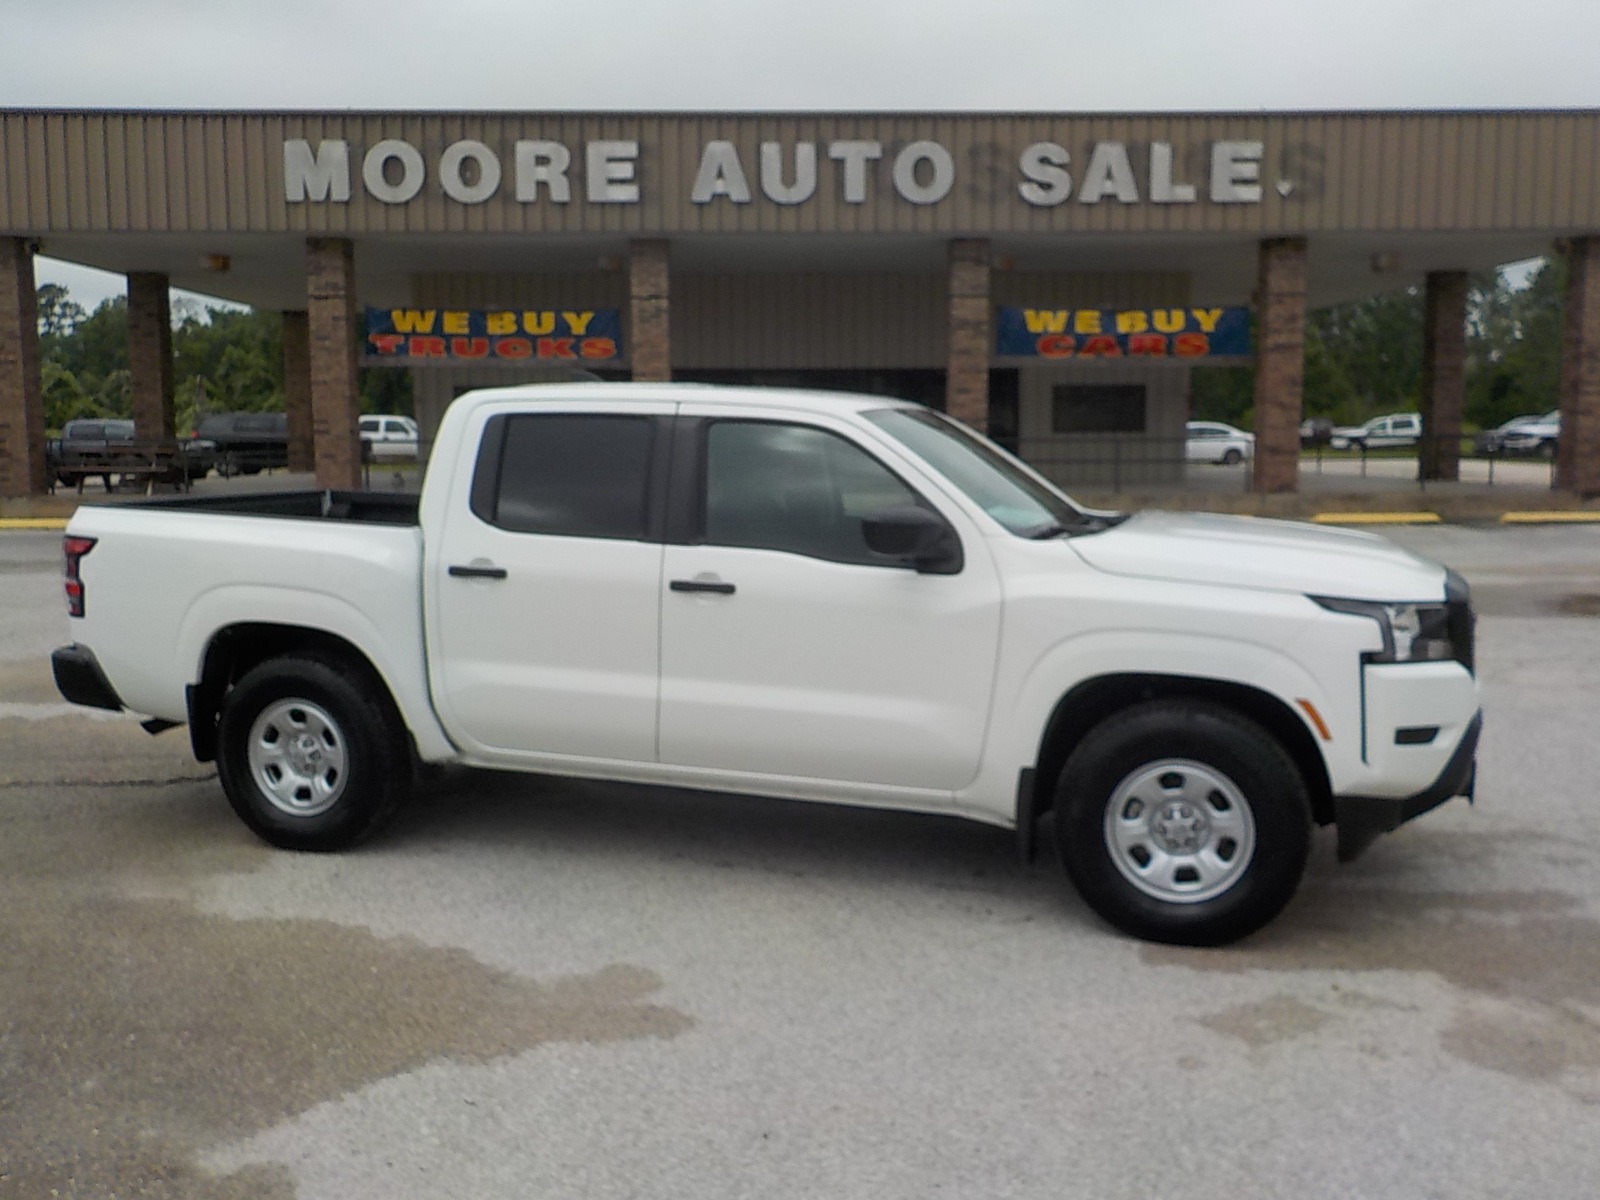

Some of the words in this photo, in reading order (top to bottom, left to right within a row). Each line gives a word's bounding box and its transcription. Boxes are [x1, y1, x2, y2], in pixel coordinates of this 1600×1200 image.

[283, 138, 641, 205] MOORE
[690, 139, 956, 205] AUTO
[1017, 141, 1325, 207] SALE
[391, 308, 471, 335] WE
[485, 310, 596, 335] BUY
[1023, 308, 1103, 334] WE
[1114, 308, 1224, 334] BUY
[368, 333, 617, 361] TRUCKS
[1035, 332, 1211, 359] CARS
